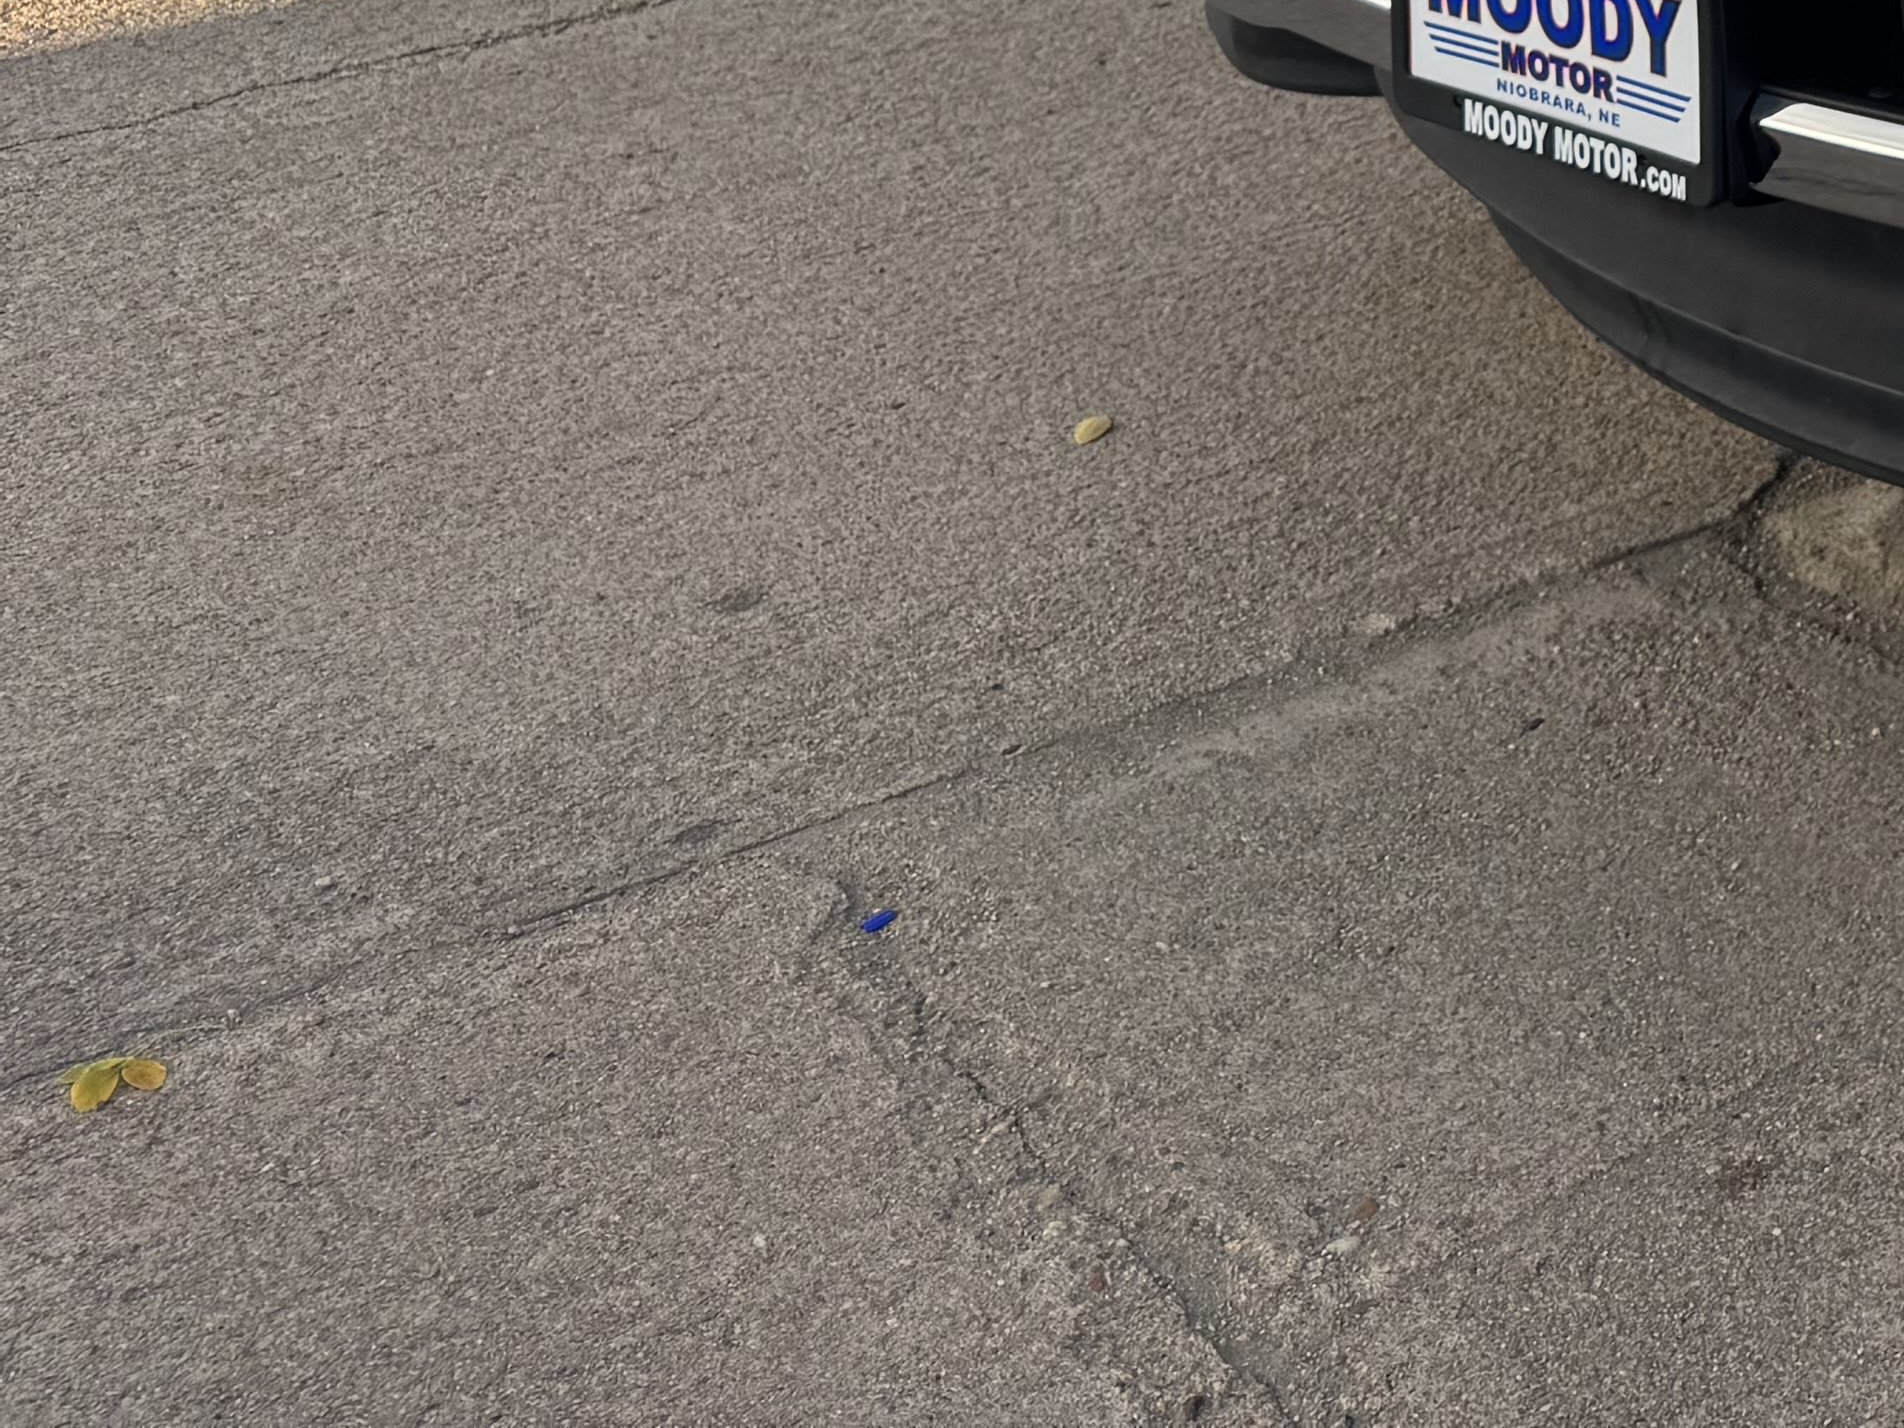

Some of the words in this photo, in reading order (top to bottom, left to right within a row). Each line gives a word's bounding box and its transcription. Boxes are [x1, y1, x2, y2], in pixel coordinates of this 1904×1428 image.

[1498, 40, 1617, 104] MOTOR
[1462, 98, 1550, 156] MOODY
[1496, 77, 1593, 123] NIOBRARA,
[1598, 106, 1622, 129] NE
